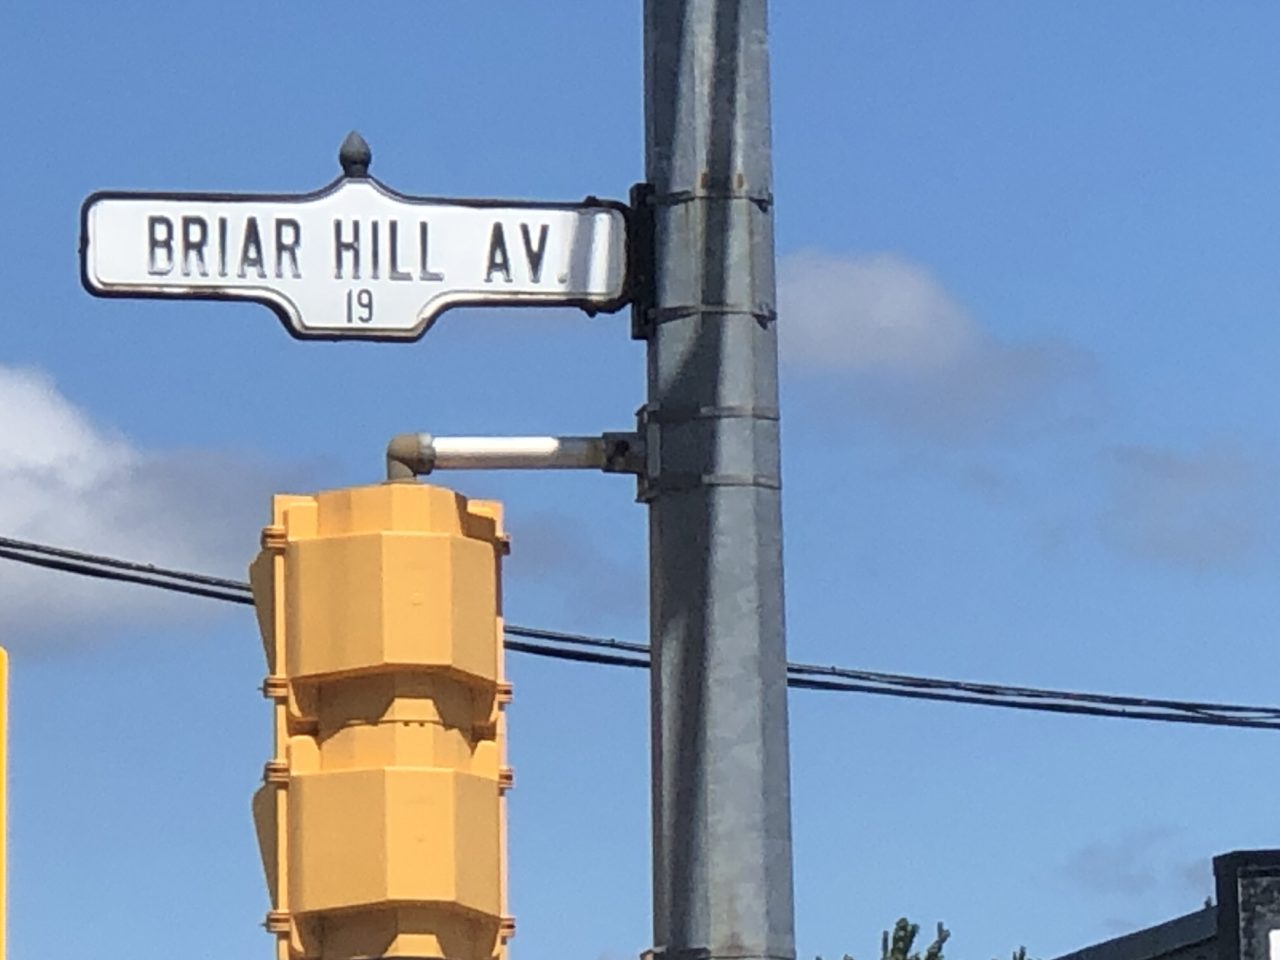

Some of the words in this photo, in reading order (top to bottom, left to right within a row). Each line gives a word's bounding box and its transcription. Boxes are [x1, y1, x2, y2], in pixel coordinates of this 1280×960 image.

[147, 215, 302, 279] BRIAR
[333, 219, 444, 281] HILL
[345, 289, 374, 323] 19
